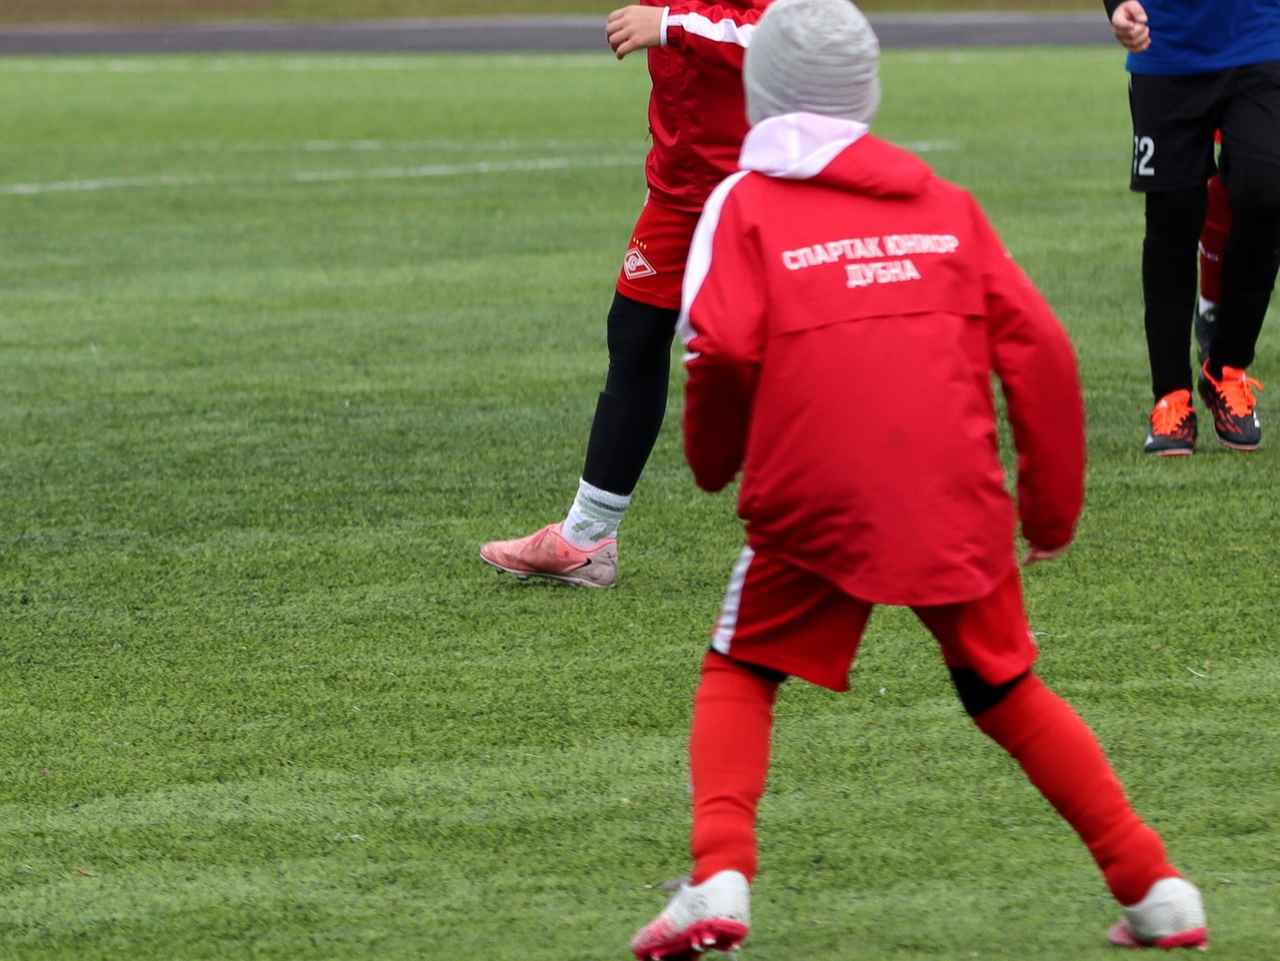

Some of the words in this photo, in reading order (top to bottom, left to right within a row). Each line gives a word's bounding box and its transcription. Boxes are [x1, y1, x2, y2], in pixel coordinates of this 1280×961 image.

[782, 237, 884, 270] СПАРТАК
[883, 234, 959, 257] ЮНИОР
[844, 259, 920, 288] ДУБНА
